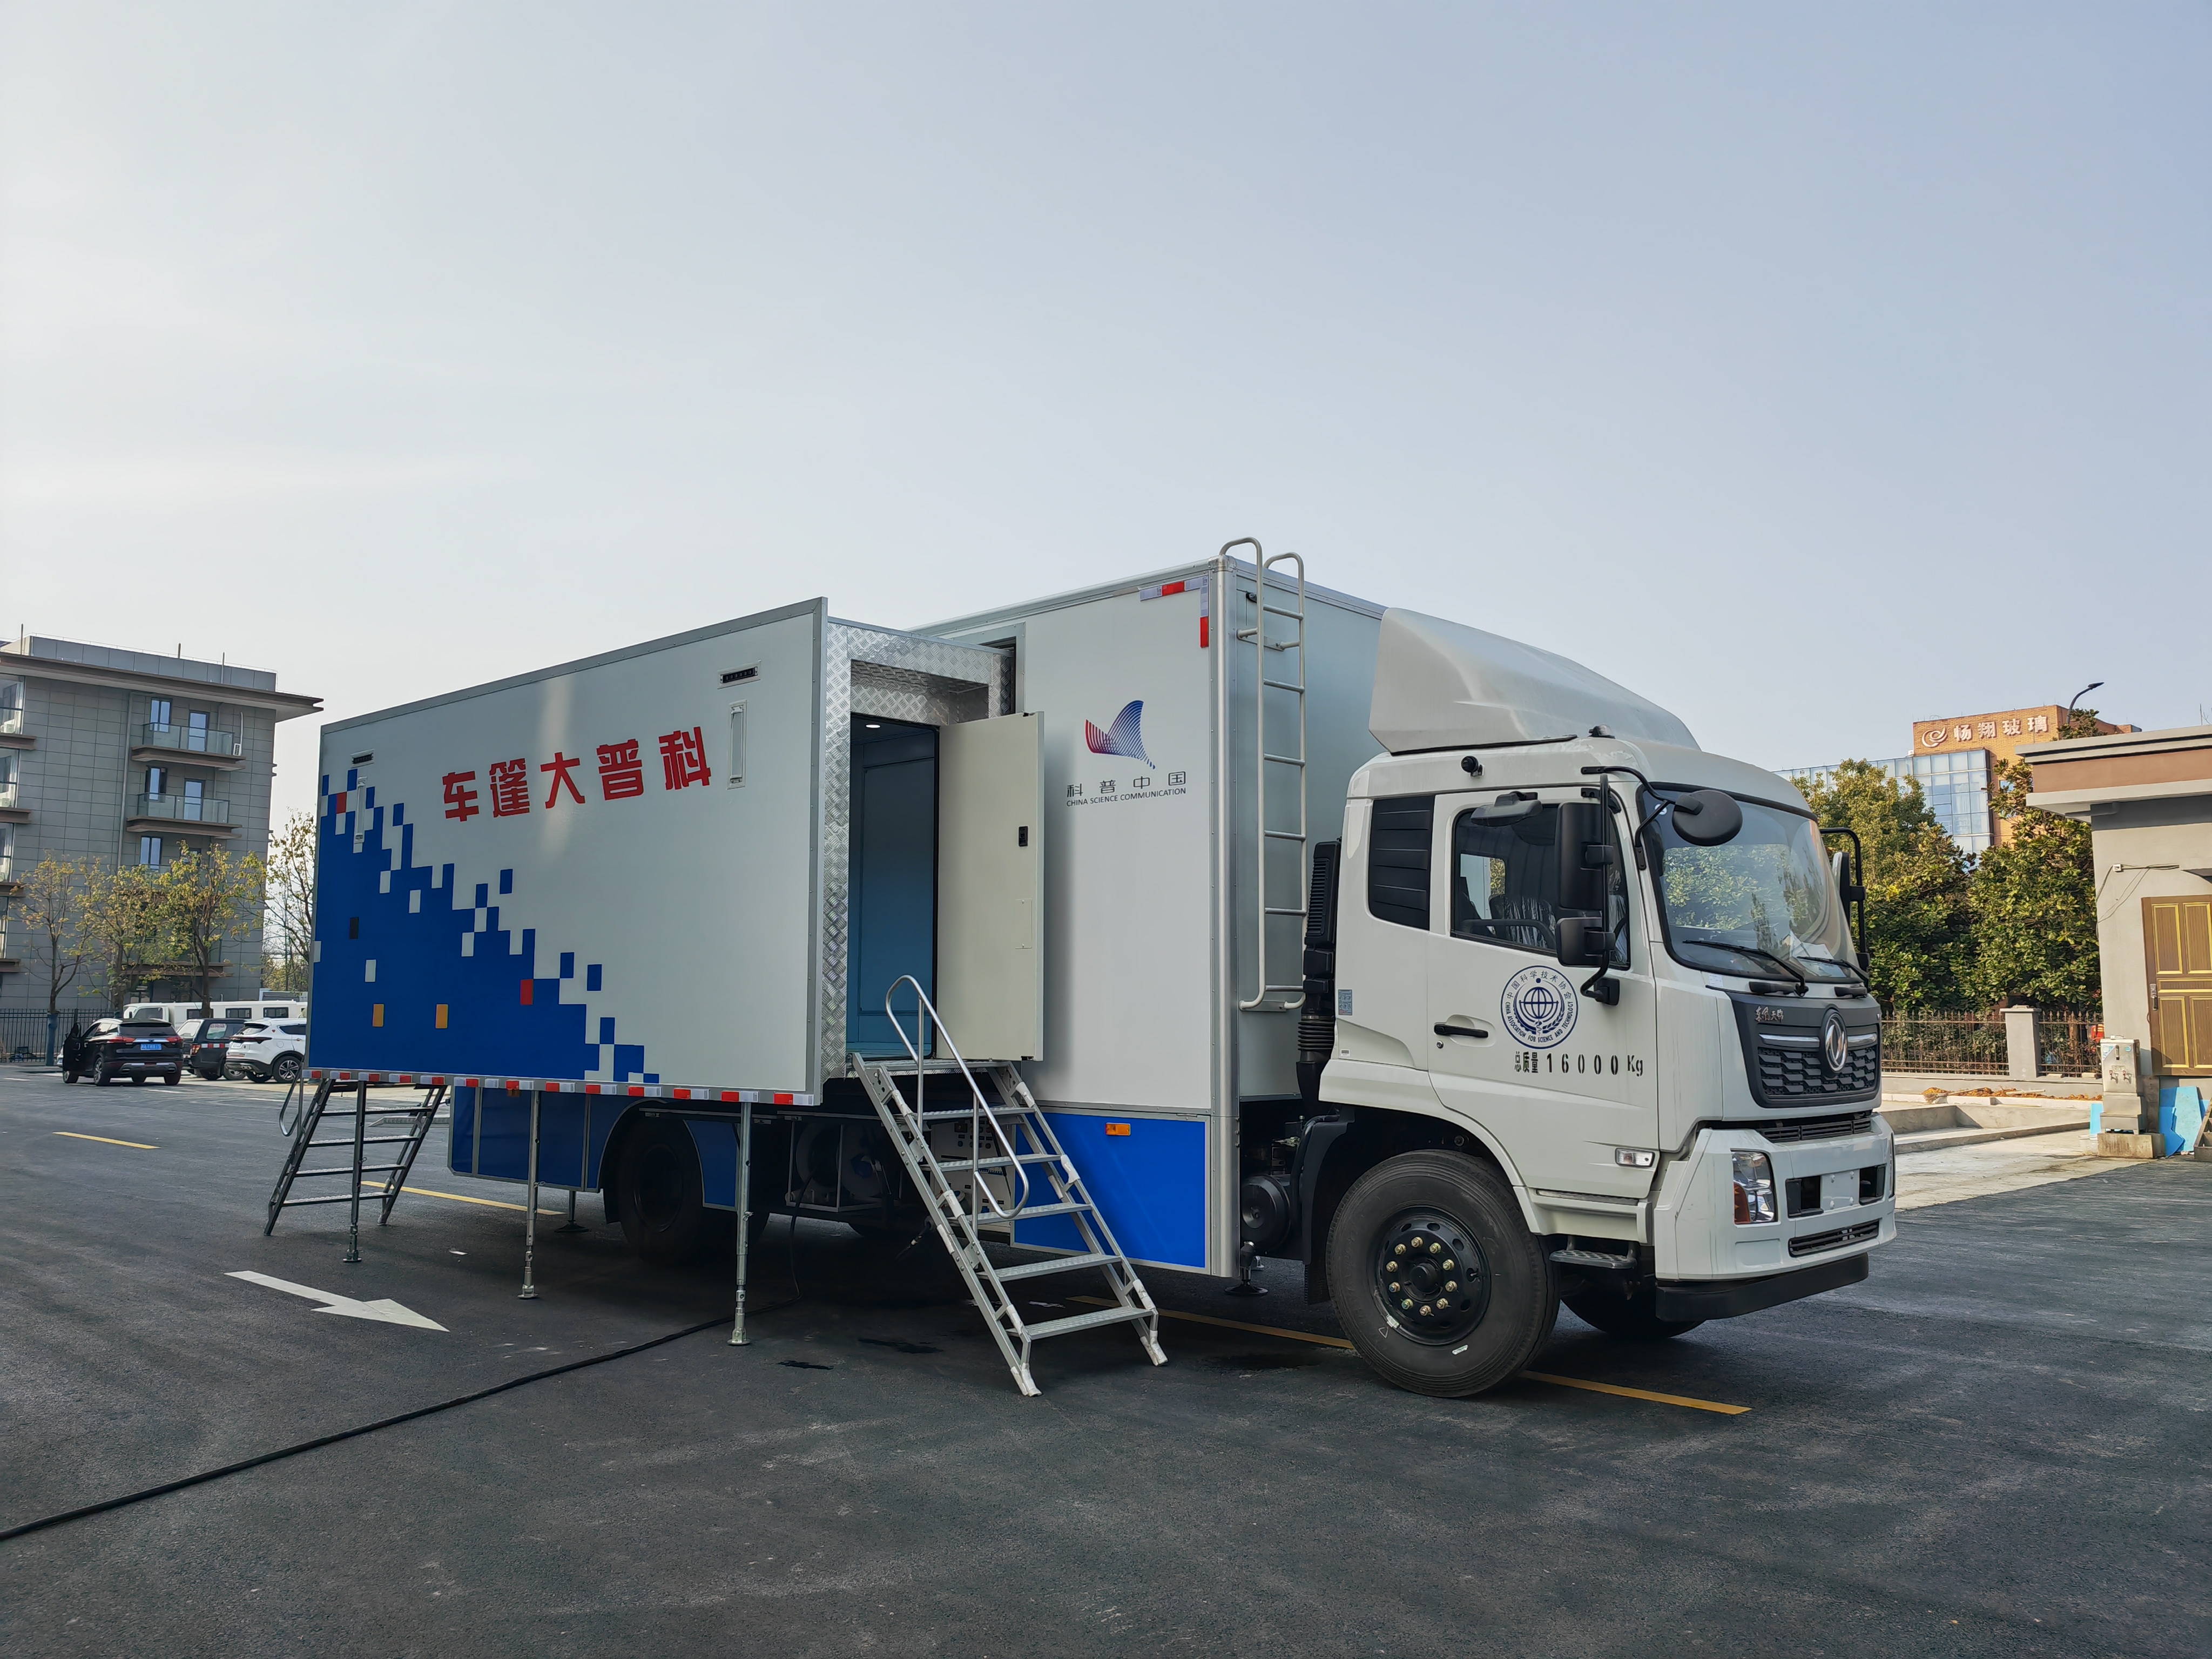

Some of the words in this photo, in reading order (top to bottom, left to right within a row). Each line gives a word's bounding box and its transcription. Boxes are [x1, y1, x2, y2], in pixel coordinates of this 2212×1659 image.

[1066, 771, 1186, 798] 科普中国
[1066, 798, 1088, 807] CHINA
[1090, 795, 1118, 804] SCIENCE
[1120, 787, 1186, 801] COMMUNICATION
[1506, 970, 1572, 1000] 中国科学技术协会
[1538, 1034, 1554, 1043] SCIENCE
[1554, 1029, 1563, 1038] AND
